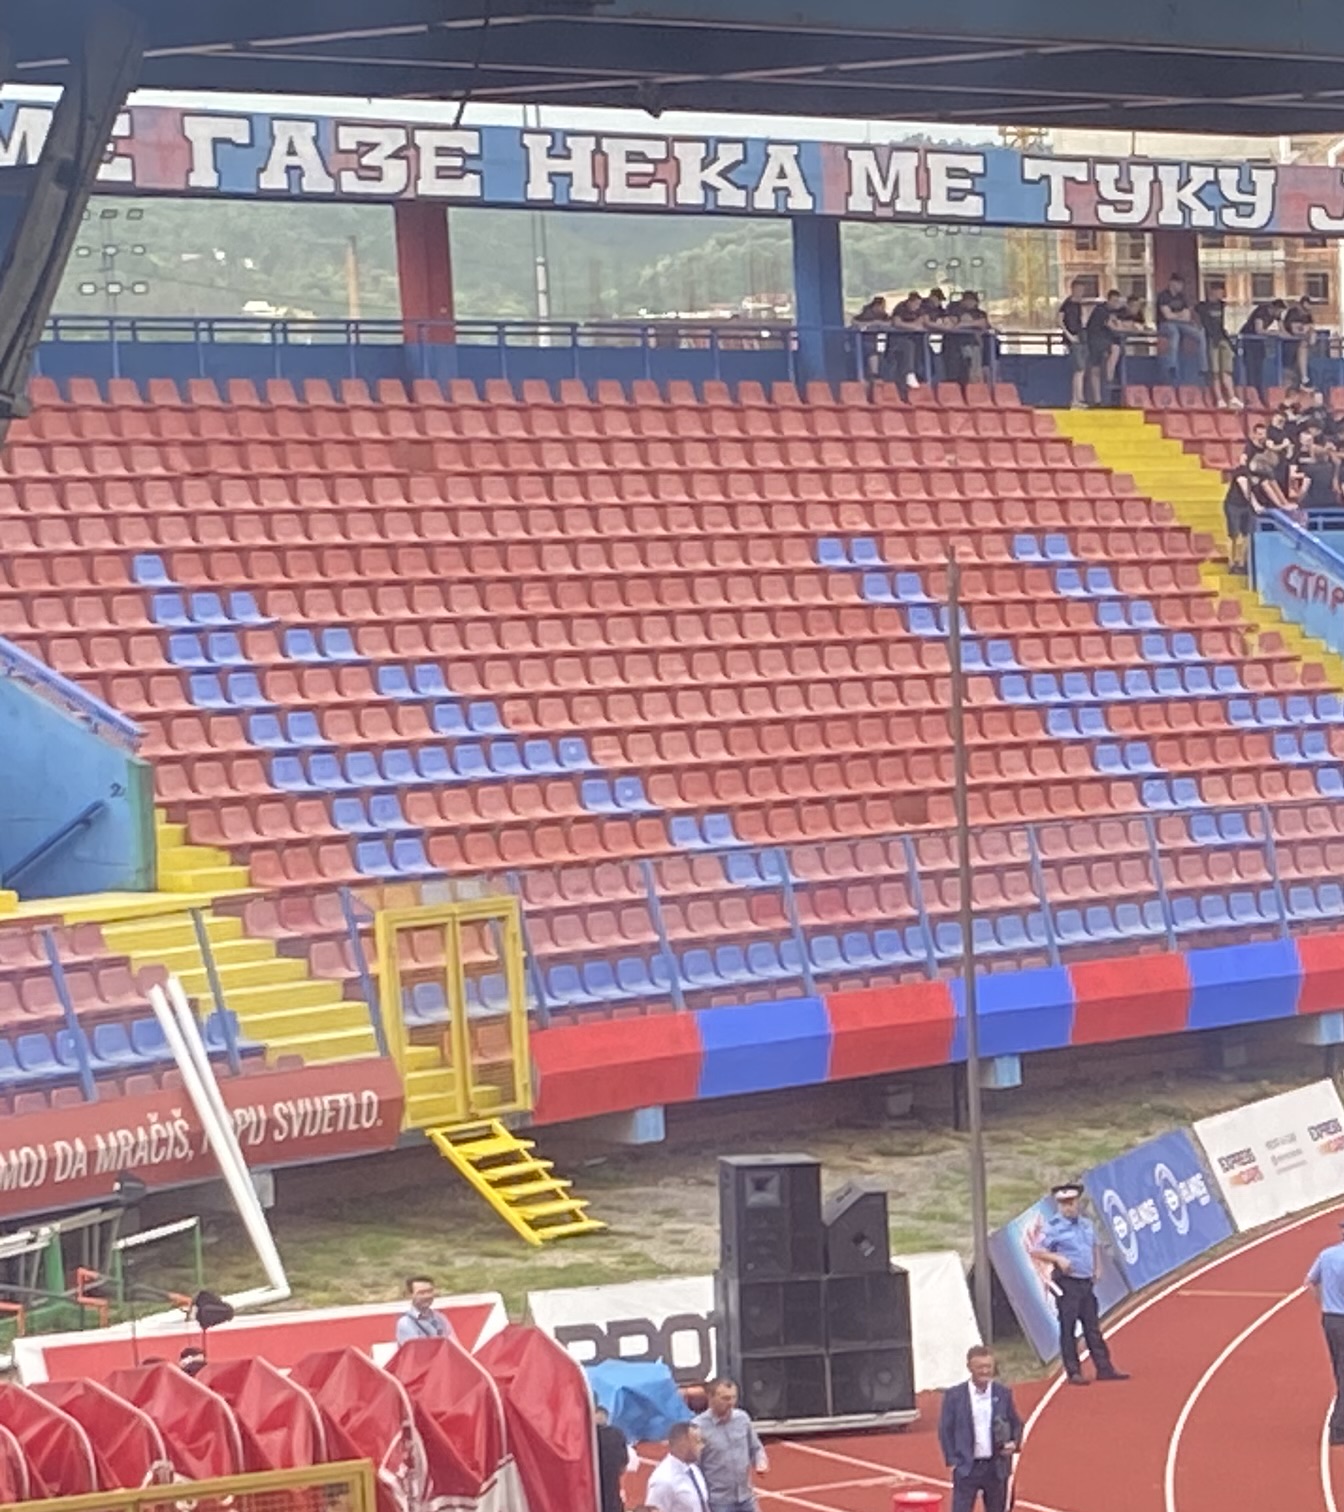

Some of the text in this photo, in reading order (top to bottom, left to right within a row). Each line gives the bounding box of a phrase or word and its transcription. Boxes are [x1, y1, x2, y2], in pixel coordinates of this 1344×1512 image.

[183, 115, 483, 198] ГАЗЕ
[522, 131, 815, 212] НЕКА
[848, 148, 986, 218] МЕ
[1023, 156, 1277, 229] ТУКУ
[53, 1137, 87, 1183] DA
[95, 1108, 193, 1176] MRAČIŠ,
[272, 1089, 383, 1142] SVIJETLO.
